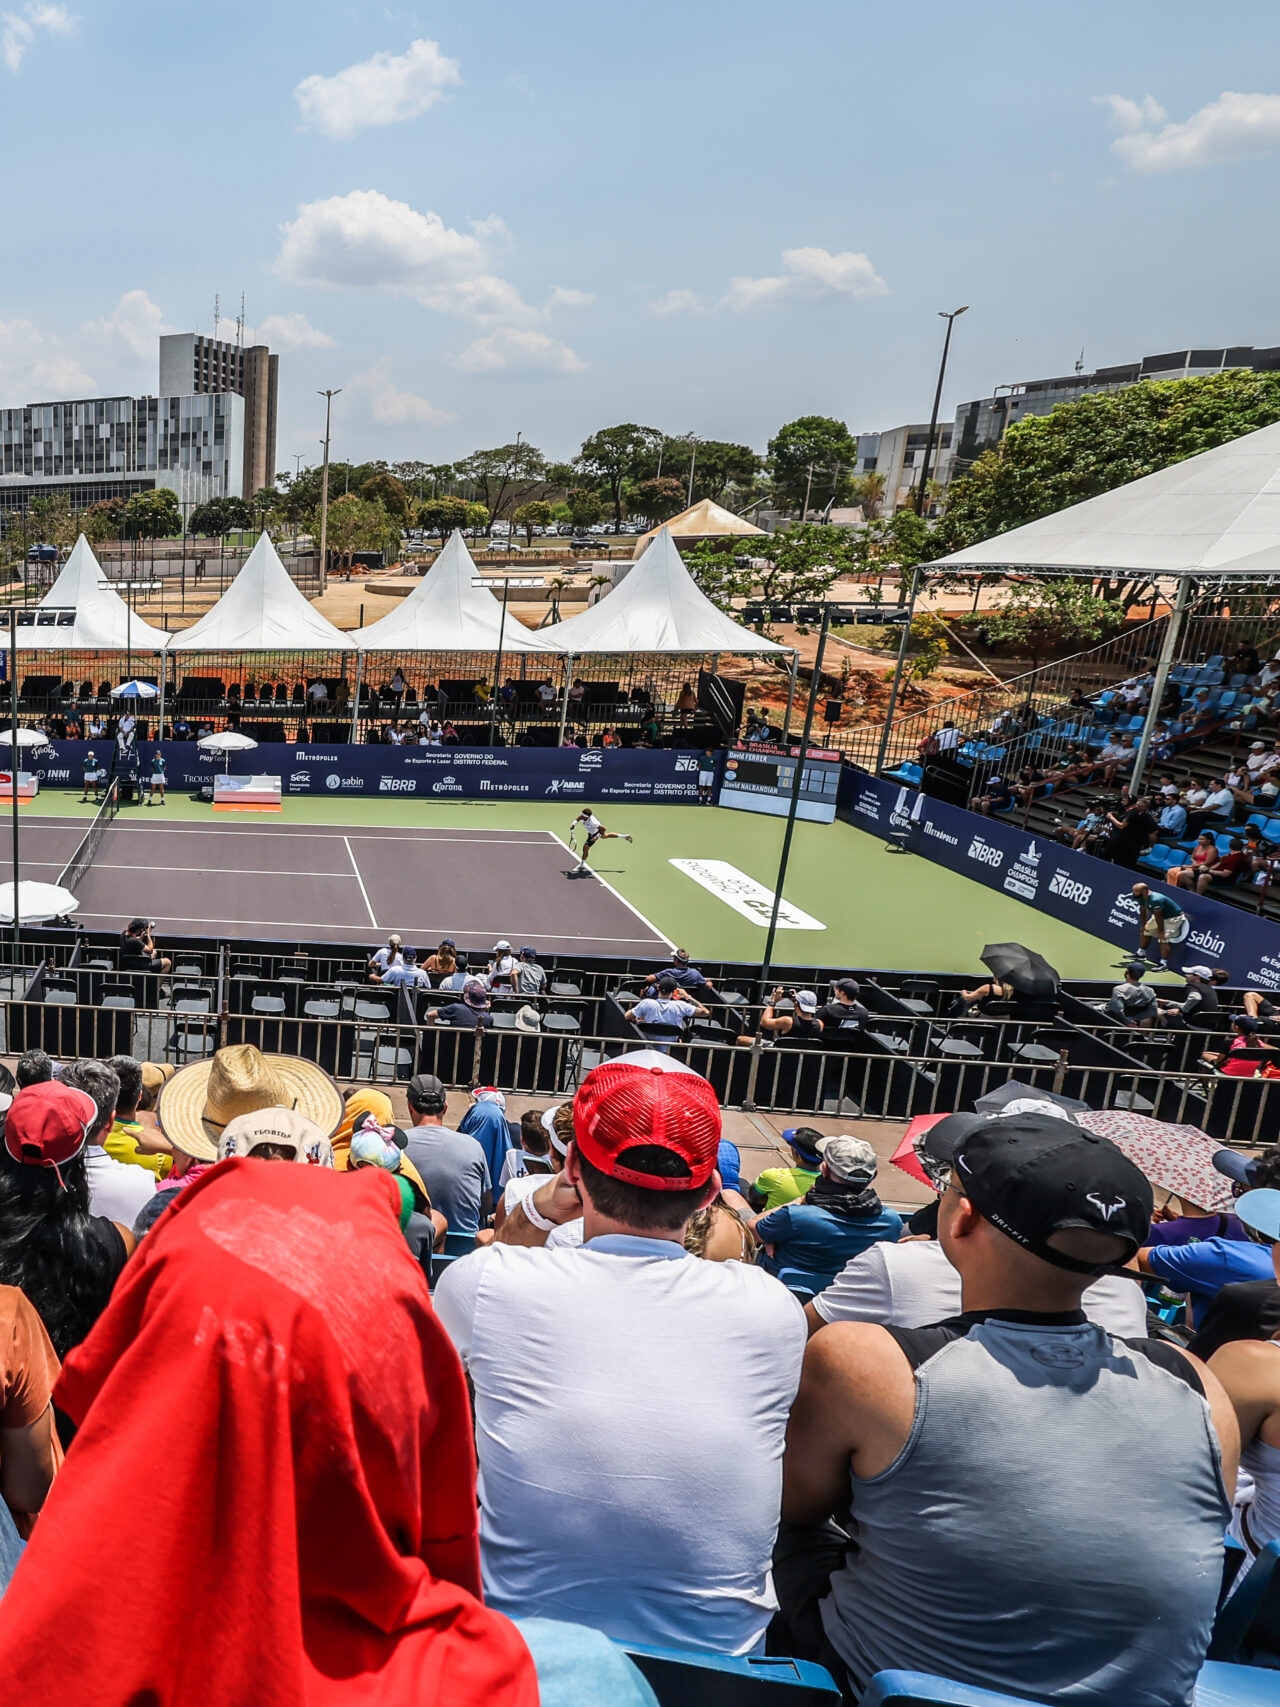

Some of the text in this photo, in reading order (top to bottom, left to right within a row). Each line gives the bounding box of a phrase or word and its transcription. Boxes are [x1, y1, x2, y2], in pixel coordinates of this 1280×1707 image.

[296, 752, 338, 761] METRÓPOLES
[580, 754, 602, 762] Sesc
[745, 753, 767, 761] FERRER
[183, 775, 213, 783] TROUSS
[342, 777, 363, 785] sabin
[392, 780, 416, 791] BRB
[433, 782, 463, 792] Corona
[480, 780, 529, 791] METRÓPOLES
[741, 784, 778, 794] NALBANDIAN
[924, 821, 958, 846] METRÓPOLES
[978, 845, 1004, 868] BRB
[1013, 862, 1037, 878] BRASÍLIA
[1056, 868, 1070, 877] banco
[1008, 869, 1039, 887] CHAMPIONS
[1061, 879, 1092, 905] BRB
[1188, 931, 1225, 954] sabin
[1260, 968, 1280, 980] GOVE
[254, 1129, 291, 1139] FLORIDA
[991, 1213, 1030, 1243] DRI-FIT
